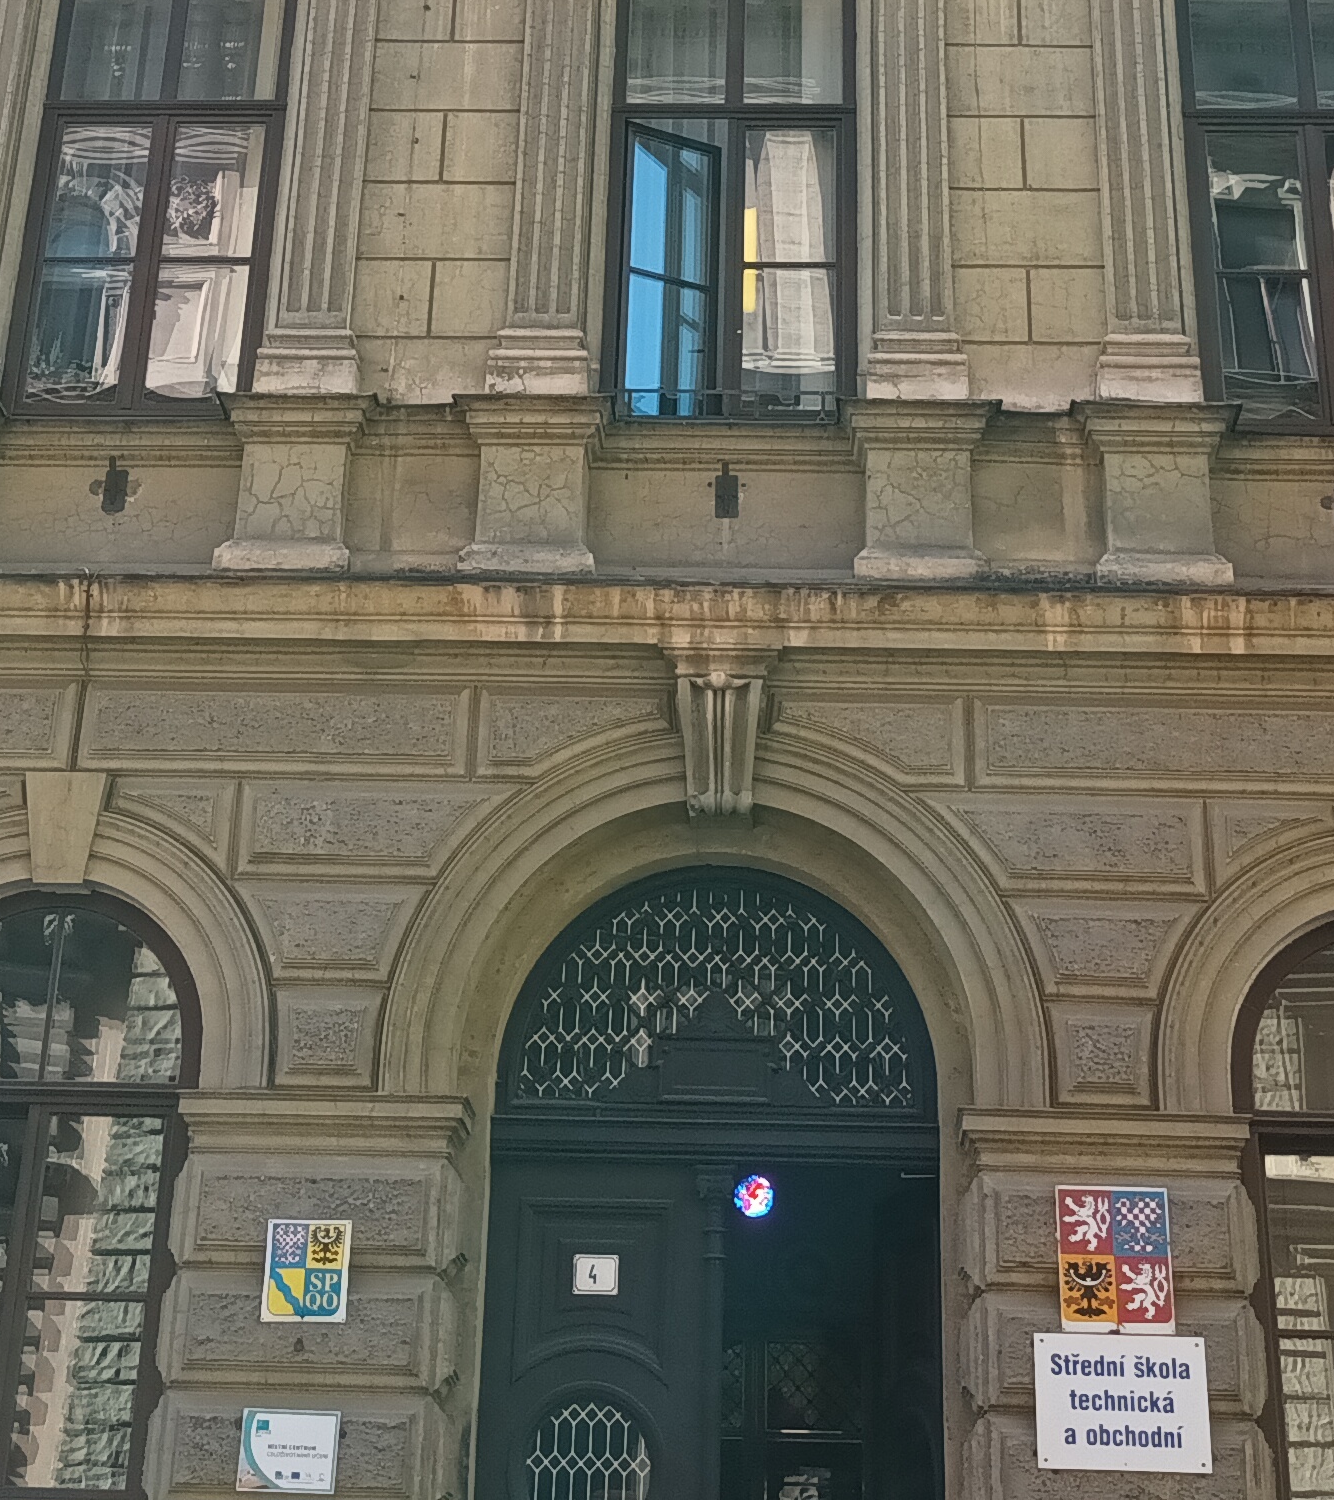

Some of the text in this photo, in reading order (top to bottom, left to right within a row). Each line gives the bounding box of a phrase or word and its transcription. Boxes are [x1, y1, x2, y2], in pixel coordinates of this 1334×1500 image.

[309, 1273, 339, 1292] SP
[589, 1264, 596, 1284] 4
[306, 1292, 339, 1311] QO
[1051, 1353, 1191, 1380] Střední škola
[1069, 1389, 1174, 1414] technická
[1064, 1423, 1184, 1449] a obchodní
